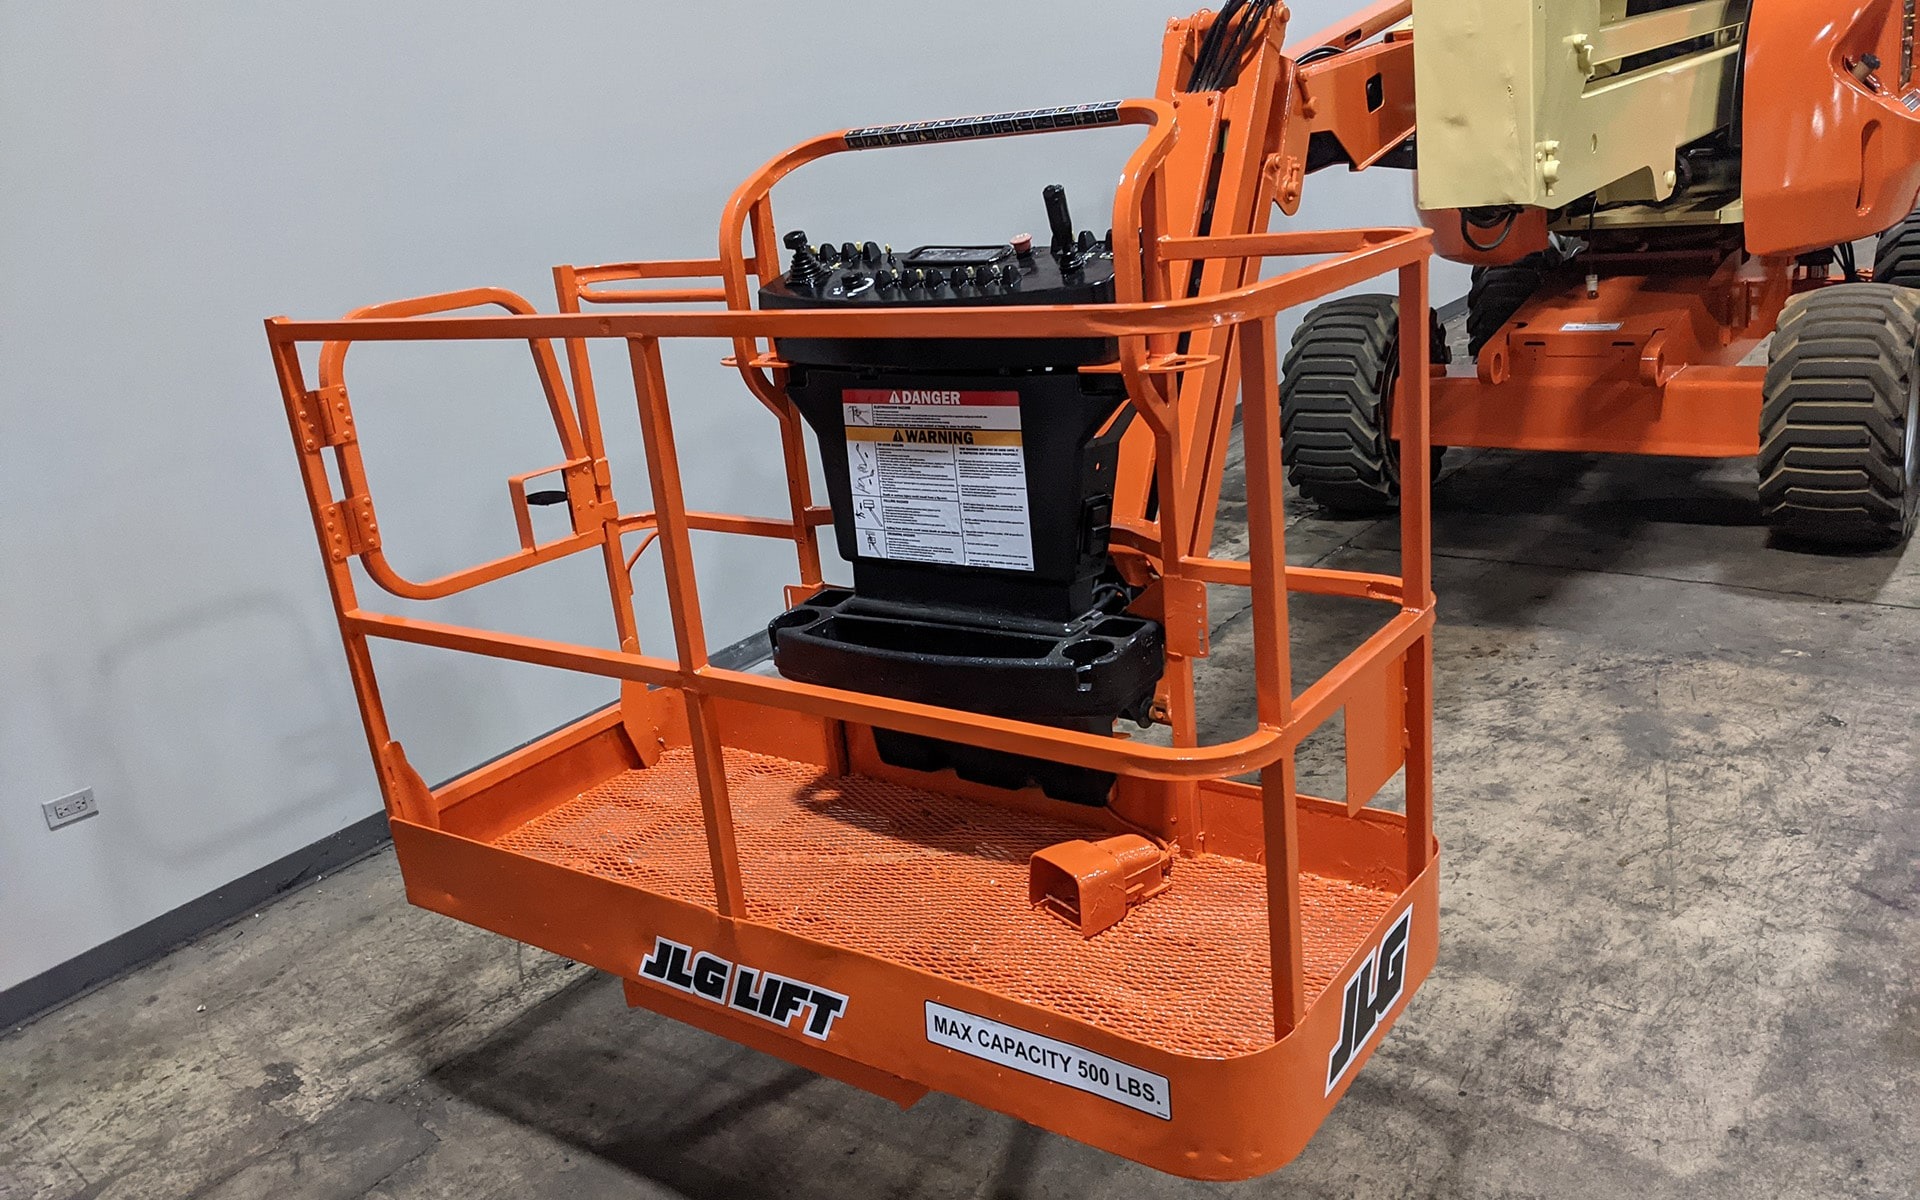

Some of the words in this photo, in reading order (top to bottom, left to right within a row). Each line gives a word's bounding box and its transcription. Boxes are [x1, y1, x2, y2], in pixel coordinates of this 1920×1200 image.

[902, 390, 960, 405] DANGER
[905, 429, 974, 445] WARNING
[641, 938, 730, 1002] JLG
[731, 968, 846, 1038] LIFT
[1327, 908, 1411, 1091] JLG
[934, 1014, 973, 1043] MAX
[977, 1029, 1072, 1073] CAPACITY
[1077, 1059, 1110, 1086] 500
[1115, 1072, 1162, 1106] LBS.
